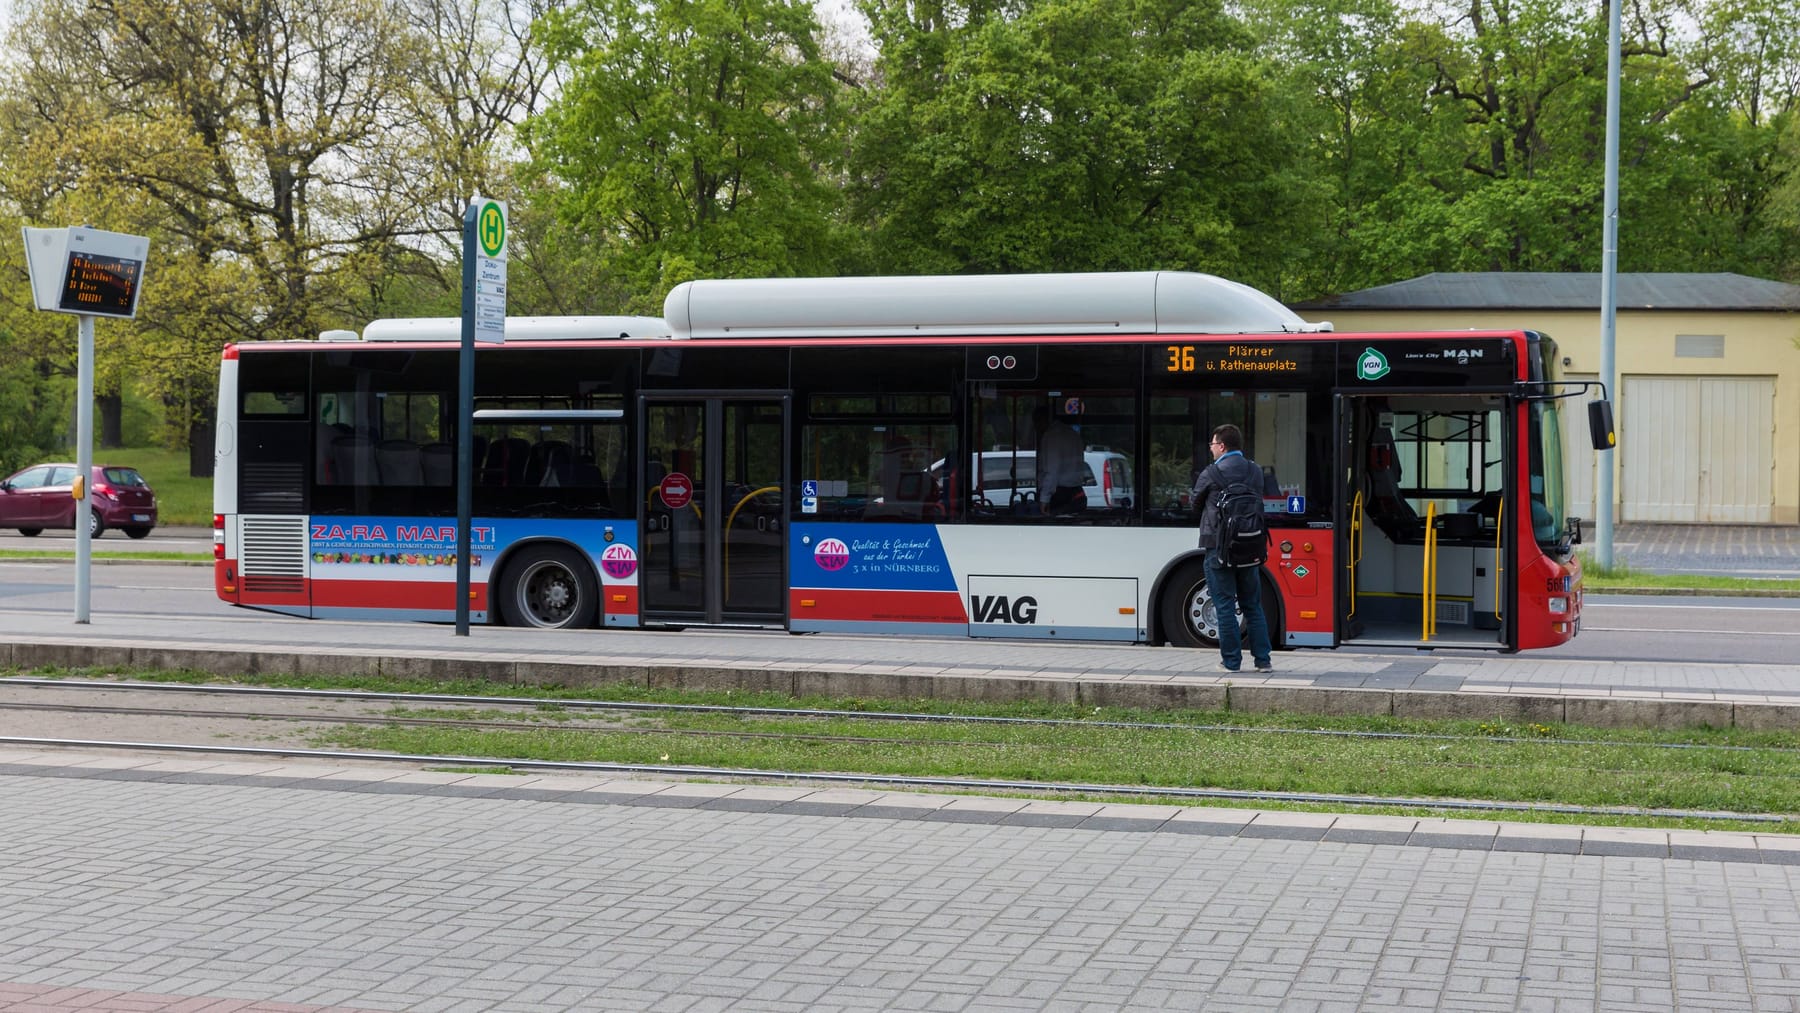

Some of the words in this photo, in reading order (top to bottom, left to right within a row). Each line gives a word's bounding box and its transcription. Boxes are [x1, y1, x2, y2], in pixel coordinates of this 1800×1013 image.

[486, 214, 498, 245] H
[1229, 345, 1274, 357] Plärrer
[1443, 349, 1484, 358] MAN
[1167, 346, 1195, 372] 36
[1364, 361, 1381, 369] VGN
[1206, 360, 1216, 370] ü.
[1220, 359, 1297, 372] Rathenauplatz
[396, 526, 491, 543] MART
[819, 541, 845, 553] ZM
[852, 539, 880, 552] Qualität
[882, 539, 890, 550] &
[893, 538, 931, 549] Geschmack
[607, 547, 632, 559] ZM
[863, 553, 875, 561] aus
[876, 551, 889, 560] der
[892, 549, 916, 561] Türkei
[853, 564, 859, 574] 3
[861, 564, 868, 572] x
[870, 563, 881, 572] in
[884, 562, 940, 573] NÜRNBERG
[971, 595, 1038, 624] VAG
